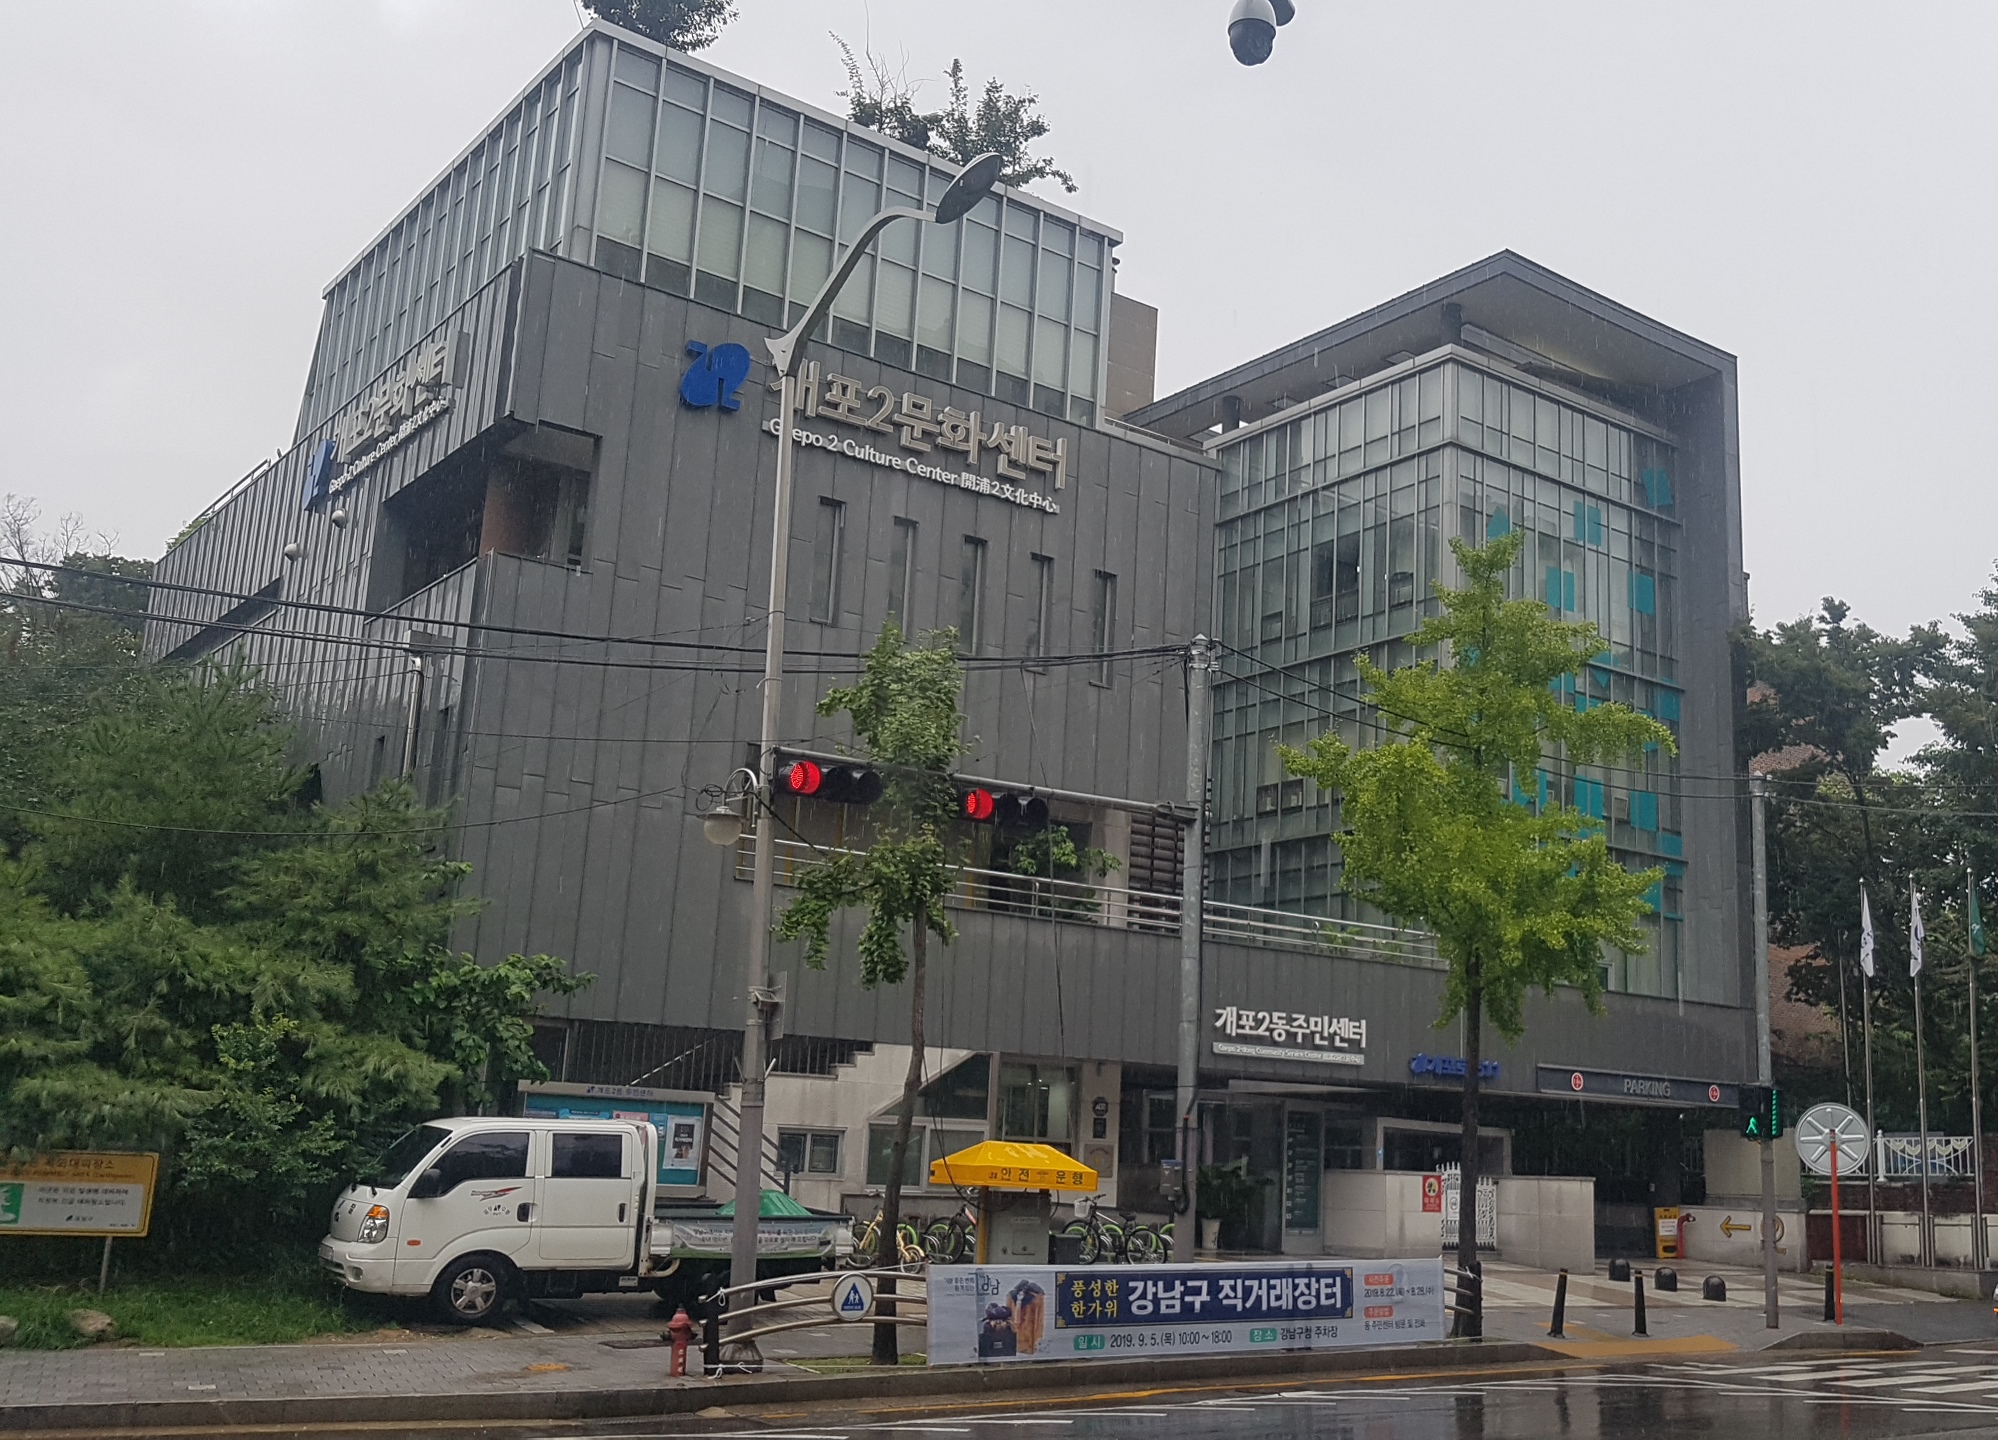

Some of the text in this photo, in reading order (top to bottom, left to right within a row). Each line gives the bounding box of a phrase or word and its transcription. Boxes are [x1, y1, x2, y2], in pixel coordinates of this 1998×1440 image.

[769, 417, 823, 447] Gepo
[828, 434, 839, 452] 2
[843, 439, 901, 470] Culture
[905, 457, 959, 486] Center
[1214, 1006, 1367, 1049] 개포2동주민센터
[1623, 1078, 1671, 1097] PARKING
[1070, 1279, 1120, 1299] 풍성한
[1128, 1276, 1342, 1316] 강남구 직거래장터
[1070, 1299, 1119, 1319] 한가위
[1077, 1335, 1101, 1349] 일시
[1253, 1325, 1339, 1341] 장소 강남구청 주차장
